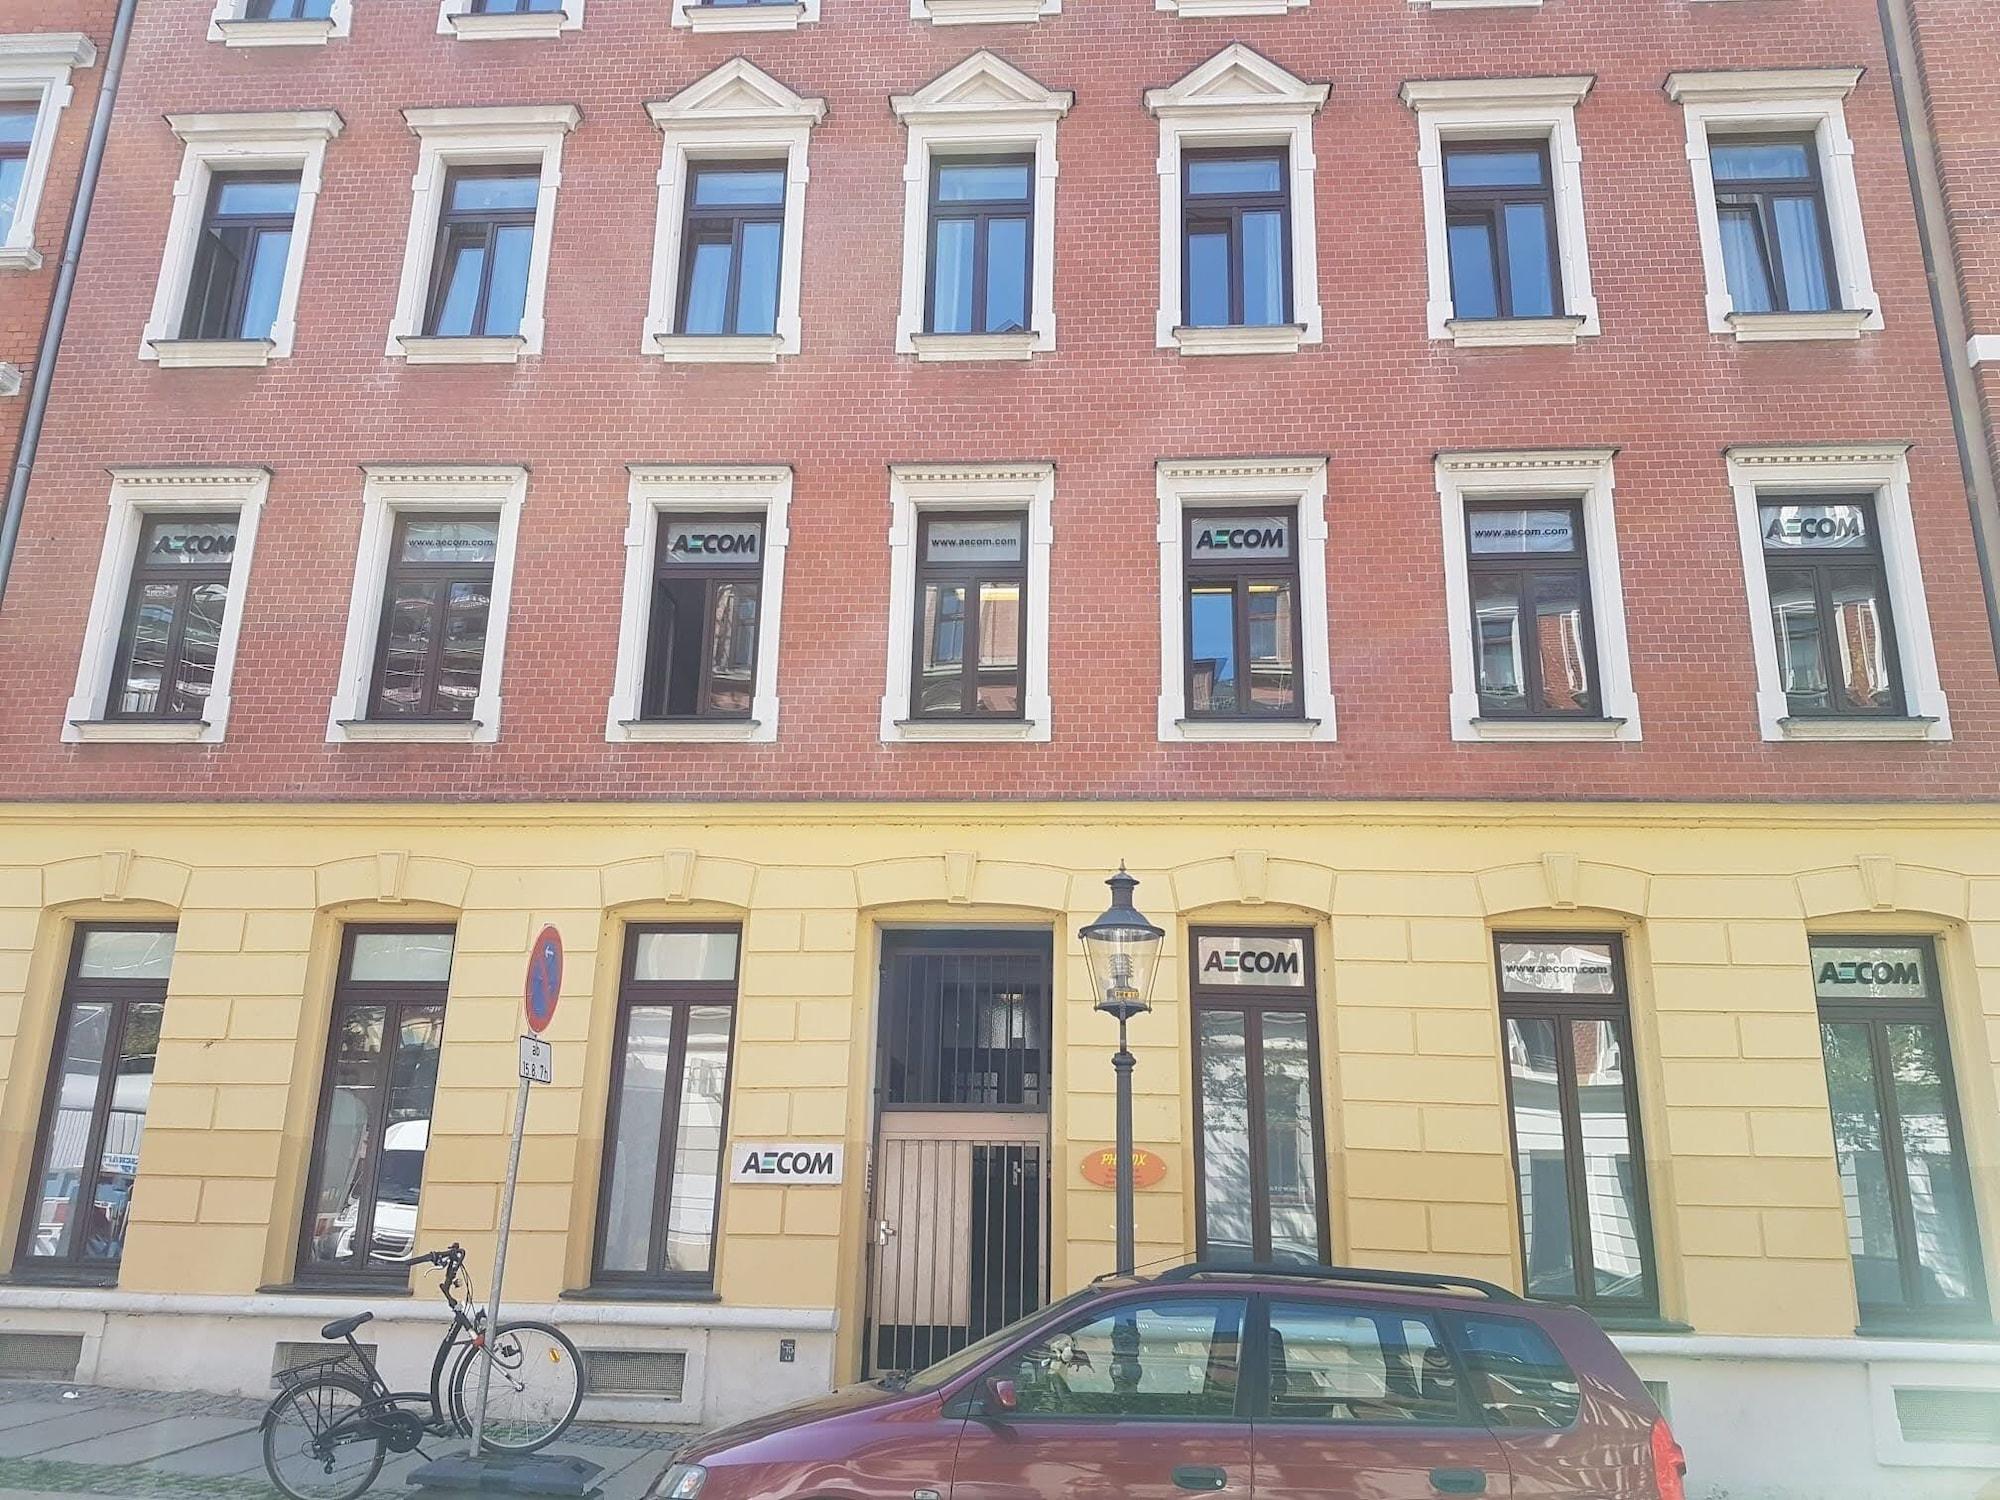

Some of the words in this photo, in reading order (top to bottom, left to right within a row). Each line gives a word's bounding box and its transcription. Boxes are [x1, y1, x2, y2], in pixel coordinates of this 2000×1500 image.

[1196, 528, 1284, 549] AECOM
[1475, 527, 1569, 538] www.aecom.com
[1765, 518, 1860, 539] AECOM
[152, 535, 236, 554] AECOM
[408, 539, 494, 548] www.aecom.com
[671, 534, 756, 554] AECOM
[931, 538, 1017, 547] www.aecom.com
[1204, 950, 1298, 974] AECOM
[1506, 963, 1608, 975] www.aecom.com
[1818, 962, 1920, 984] AECOM
[741, 1152, 833, 1174] AECOM
